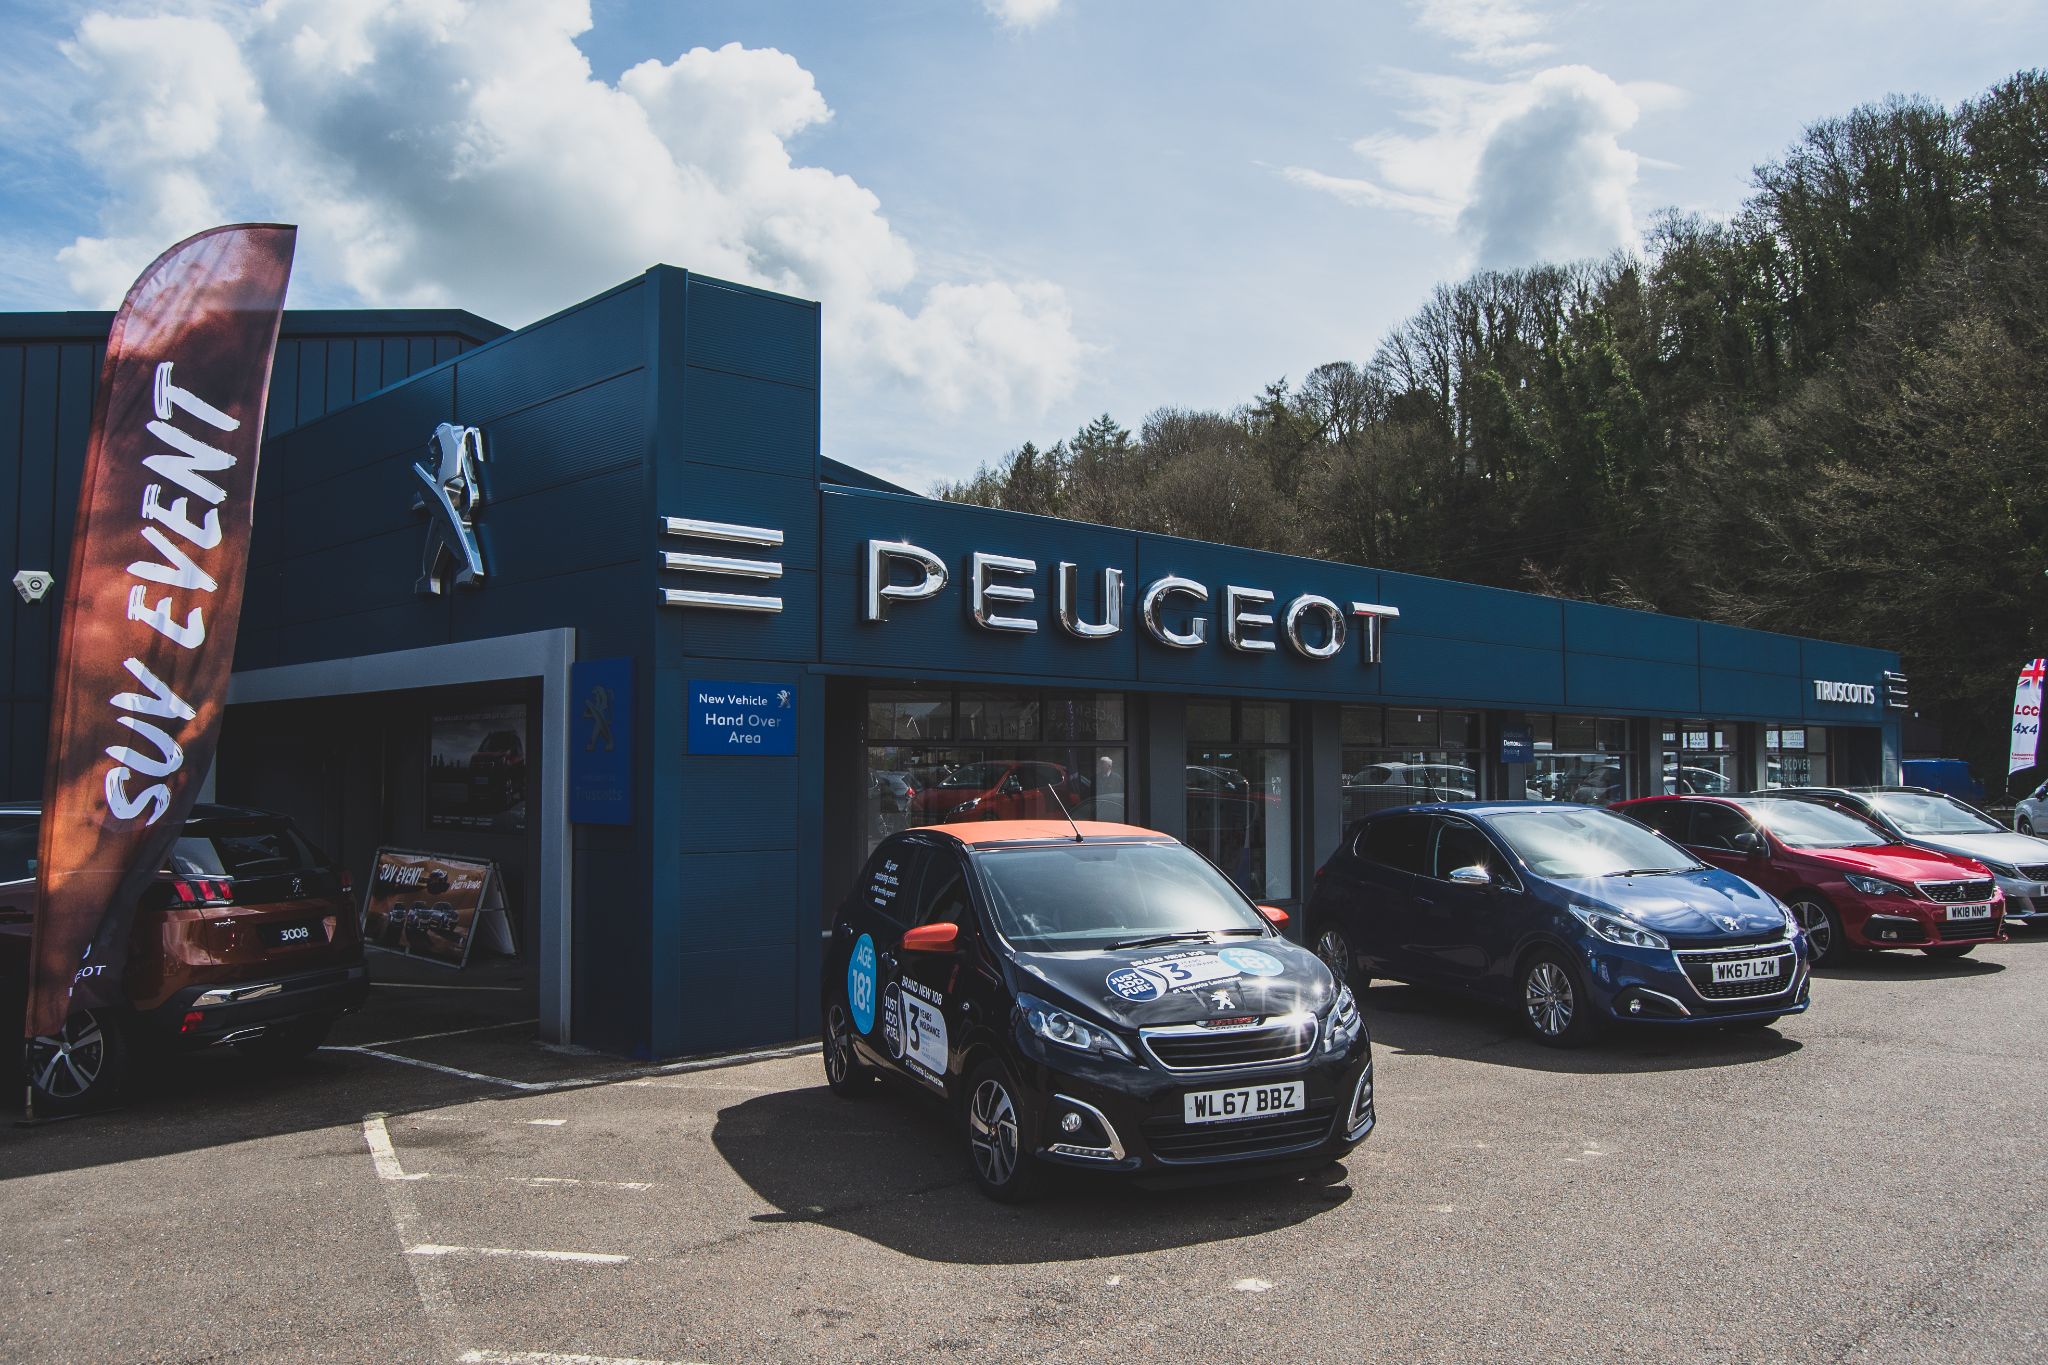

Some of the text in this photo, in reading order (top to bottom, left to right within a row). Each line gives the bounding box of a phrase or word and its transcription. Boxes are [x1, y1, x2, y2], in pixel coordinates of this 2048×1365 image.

[105, 361, 240, 827] SUV EVENT
[863, 539, 1400, 664] PEUGEOT
[699, 693, 768, 706] New Vehicle
[1813, 680, 1875, 704] TRUSCOTTS
[705, 713, 782, 727] Hand Over
[2013, 722, 2038, 734] 4x4
[728, 731, 761, 744] Area
[379, 863, 425, 886] SUV EVENT
[1951, 905, 1987, 918] WK18 NNP
[280, 927, 309, 941] 3008
[857, 944, 872, 969] AGE
[1110, 972, 1137, 985] JUST
[1159, 962, 1192, 980] 3
[1718, 960, 1775, 979] WK67 LZW
[853, 969, 871, 1014] 18?
[901, 975, 919, 993] BRAND
[919, 983, 932, 1000] NEW
[1118, 978, 1145, 991] ADD
[1122, 983, 1153, 997] FUEL
[884, 996, 897, 1011] JUST
[885, 1011, 898, 1027] ADD
[908, 1002, 920, 1052] 3
[886, 1024, 900, 1042] FUEL
[1194, 1086, 1295, 1117] WL67 BBZ
